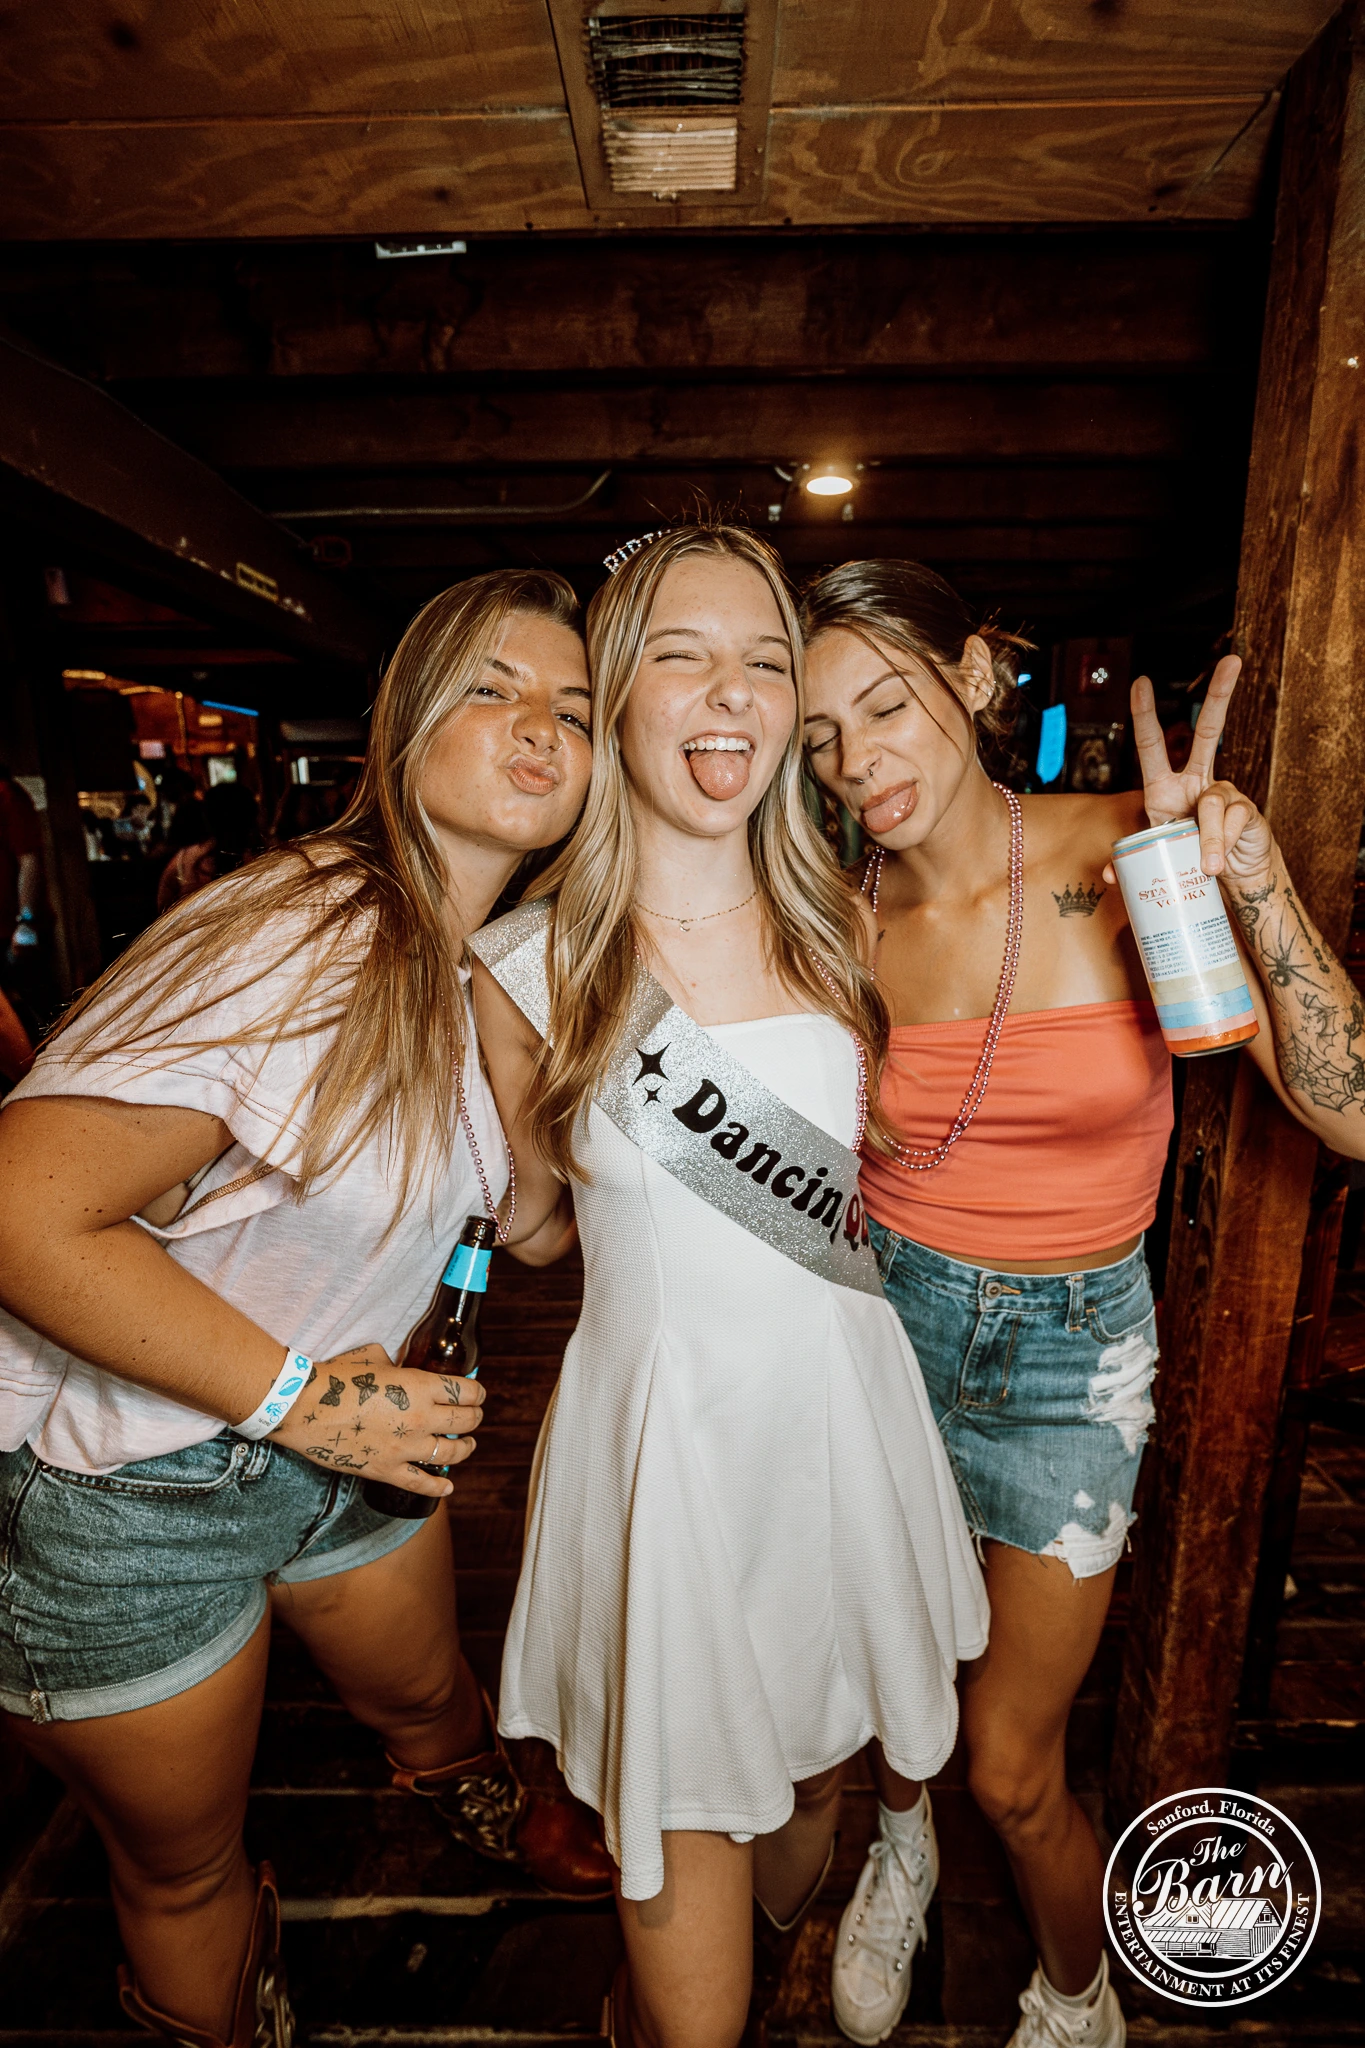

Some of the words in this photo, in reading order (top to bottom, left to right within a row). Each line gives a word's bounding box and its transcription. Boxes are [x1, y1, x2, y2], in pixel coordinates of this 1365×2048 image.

[1138, 874, 1213, 901] STAESIDE
[1156, 889, 1206, 908] VOKA
[672, 1078, 847, 1245] Dancin
